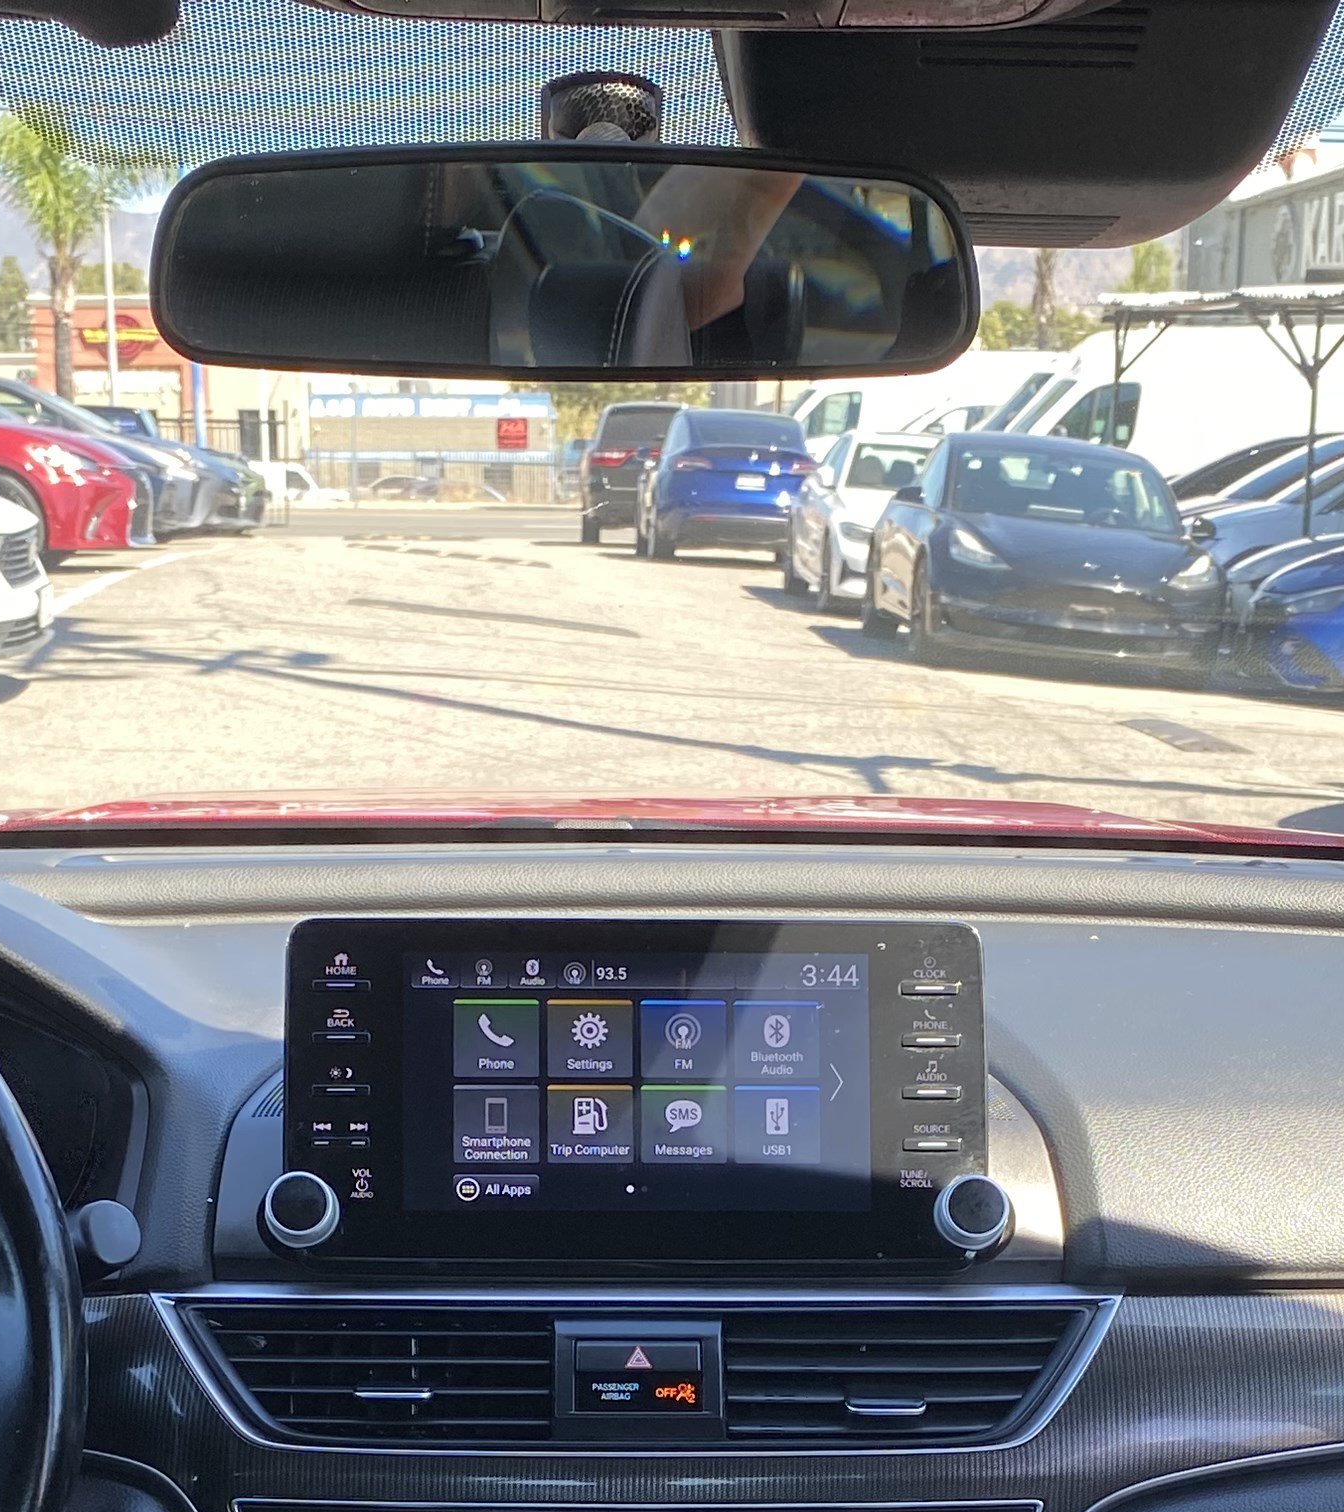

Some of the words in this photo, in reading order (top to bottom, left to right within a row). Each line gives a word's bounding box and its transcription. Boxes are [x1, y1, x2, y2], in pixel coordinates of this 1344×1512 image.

[325, 966, 357, 975] HOME
[596, 967, 627, 980] 93.5
[801, 963, 860, 987] 3:44
[913, 970, 947, 979] CLOCK
[422, 976, 450, 986] Phone
[476, 976, 492, 985] FM
[520, 976, 546, 985] Audio
[326, 1018, 355, 1027] BACK
[913, 1022, 948, 1030] PHONE
[751, 1052, 804, 1062] Bluetooth
[478, 1058, 515, 1070] Phone
[567, 1058, 613, 1072] Settings
[674, 1059, 694, 1069] FM
[761, 1065, 793, 1075] Audio
[916, 1073, 947, 1081] AUDIO
[669, 1108, 699, 1120] SMS
[913, 1125, 951, 1134] SOURCE
[461, 1136, 531, 1149] Smartphone
[464, 1149, 528, 1160] Connection
[550, 1144, 573, 1157] Trip
[574, 1144, 630, 1157] Computer
[655, 1145, 713, 1157] Messages
[762, 1145, 791, 1155] USB1
[352, 1168, 373, 1178] VOL
[900, 1170, 928, 1179] TUNE/
[900, 1179, 933, 1188] SCROLL
[350, 1191, 374, 1199] AUDIO
[485, 1184, 500, 1195] All
[502, 1184, 532, 1197] Apps
[592, 1382, 640, 1391] PASSENGER
[601, 1392, 631, 1400] AIRBAG
[655, 1387, 677, 1398] OFF
